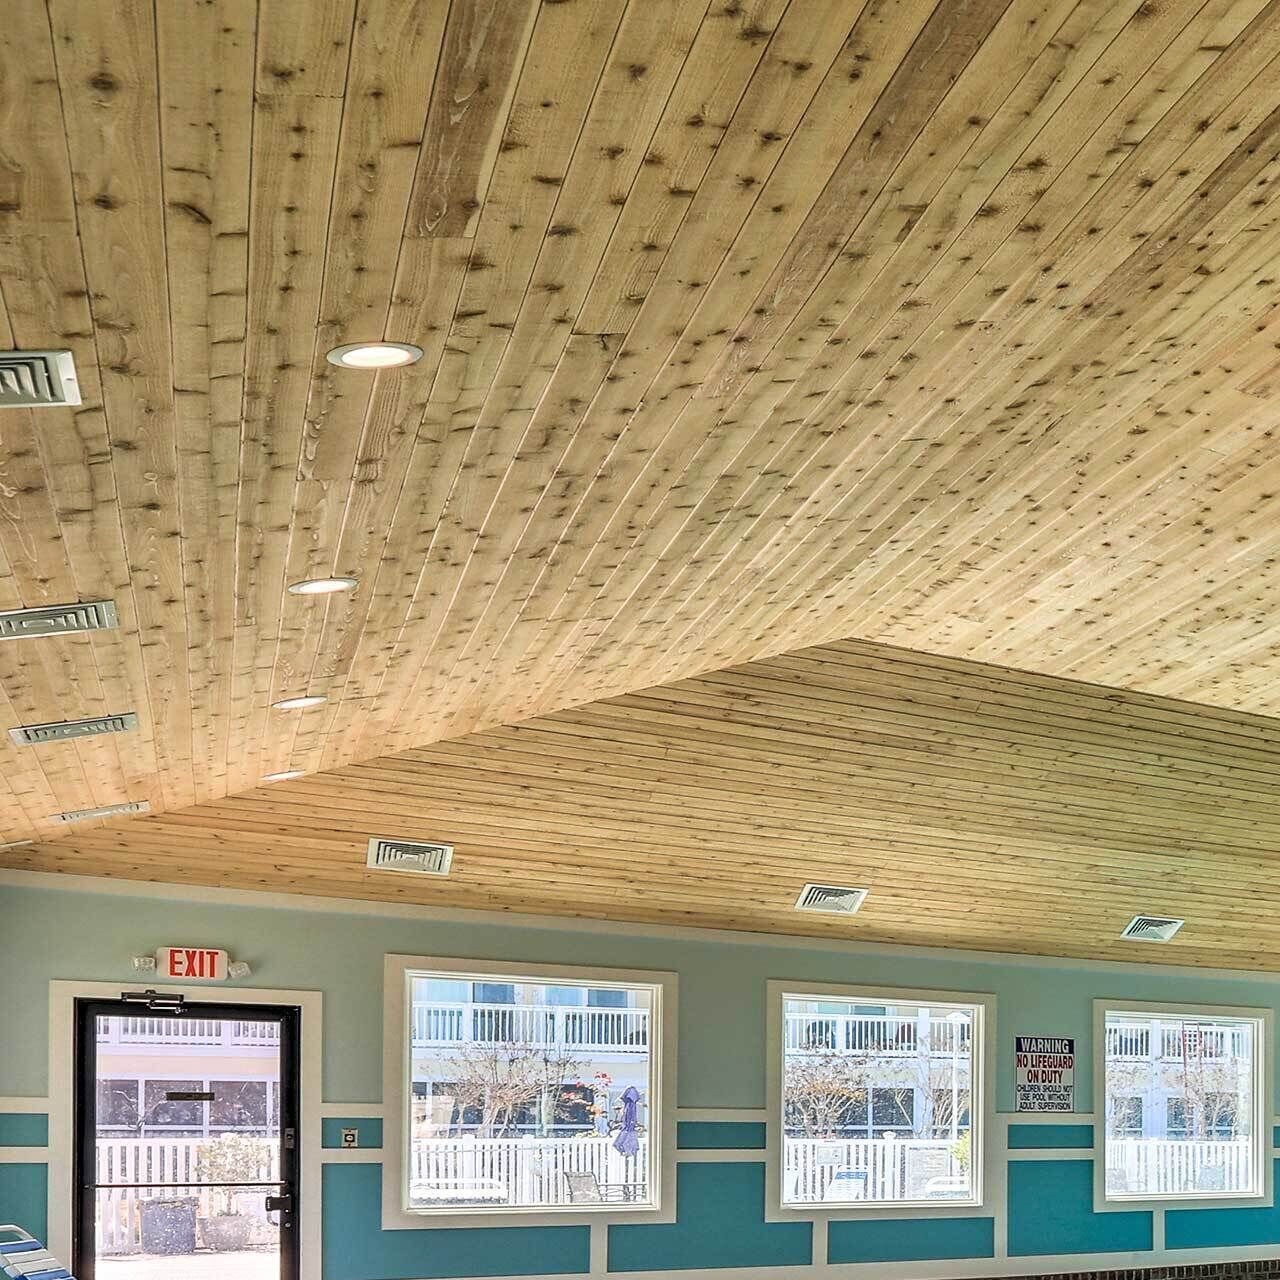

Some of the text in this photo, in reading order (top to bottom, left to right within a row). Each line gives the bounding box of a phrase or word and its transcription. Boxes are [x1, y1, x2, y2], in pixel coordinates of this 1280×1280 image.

[169, 949, 219, 977] EXIT
[1020, 1038, 1070, 1053] WARNING
[1017, 1054, 1074, 1069] NO LIFEGUARD
[1027, 1069, 1063, 1084] ON DUTY
[1016, 1084, 1072, 1093] CHILDREN SHOULD NOT
[1032, 1093, 1046, 1101] POOL
[1020, 1101, 1071, 1110] ADULT SUPERVISION
